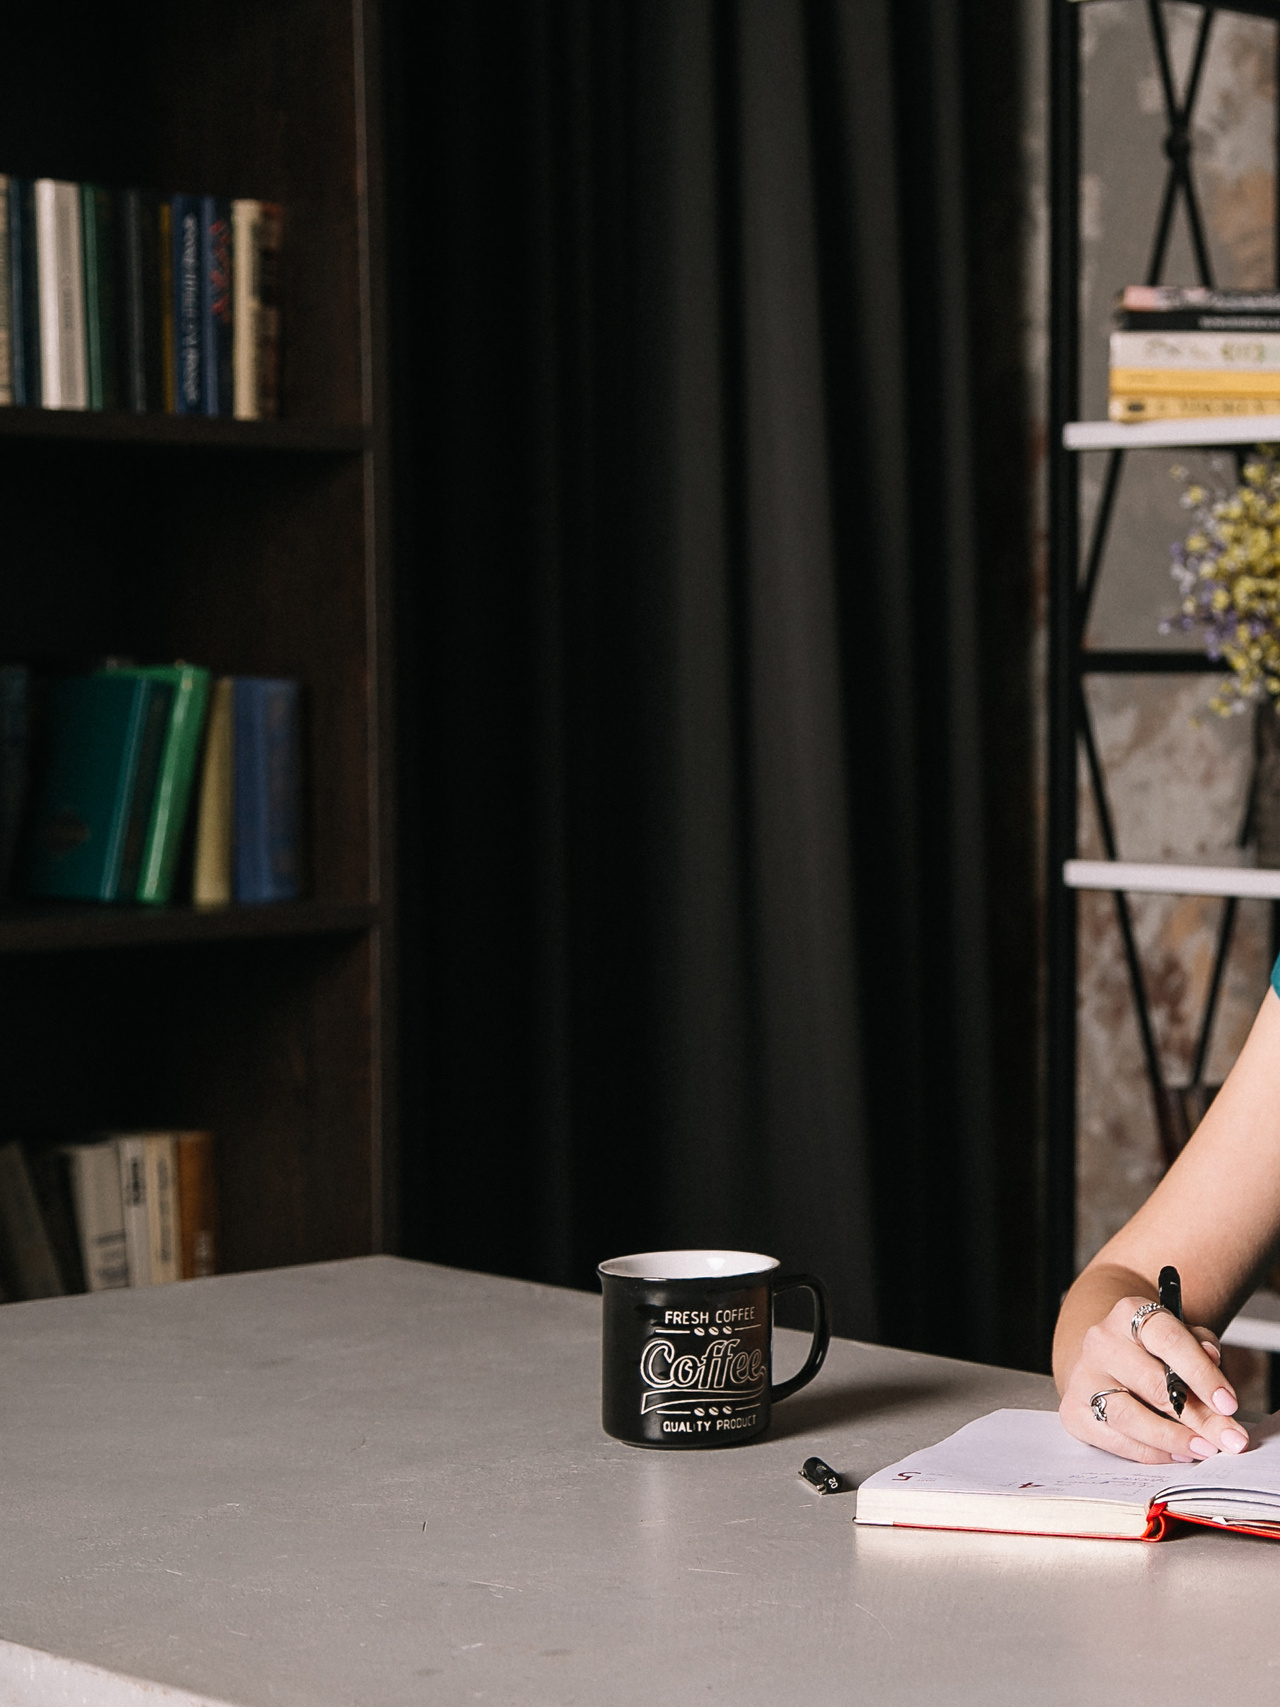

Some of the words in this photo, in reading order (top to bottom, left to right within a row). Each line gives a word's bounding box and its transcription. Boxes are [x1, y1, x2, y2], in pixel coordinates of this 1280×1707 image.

[665, 1311, 709, 1324] FRESH
[716, 1306, 755, 1323] COFFEE
[640, 1338, 765, 1389] Coffee
[716, 1414, 757, 1431] PRODUCT
[828, 1477, 838, 1489] 02
[892, 1471, 921, 1481] 5
